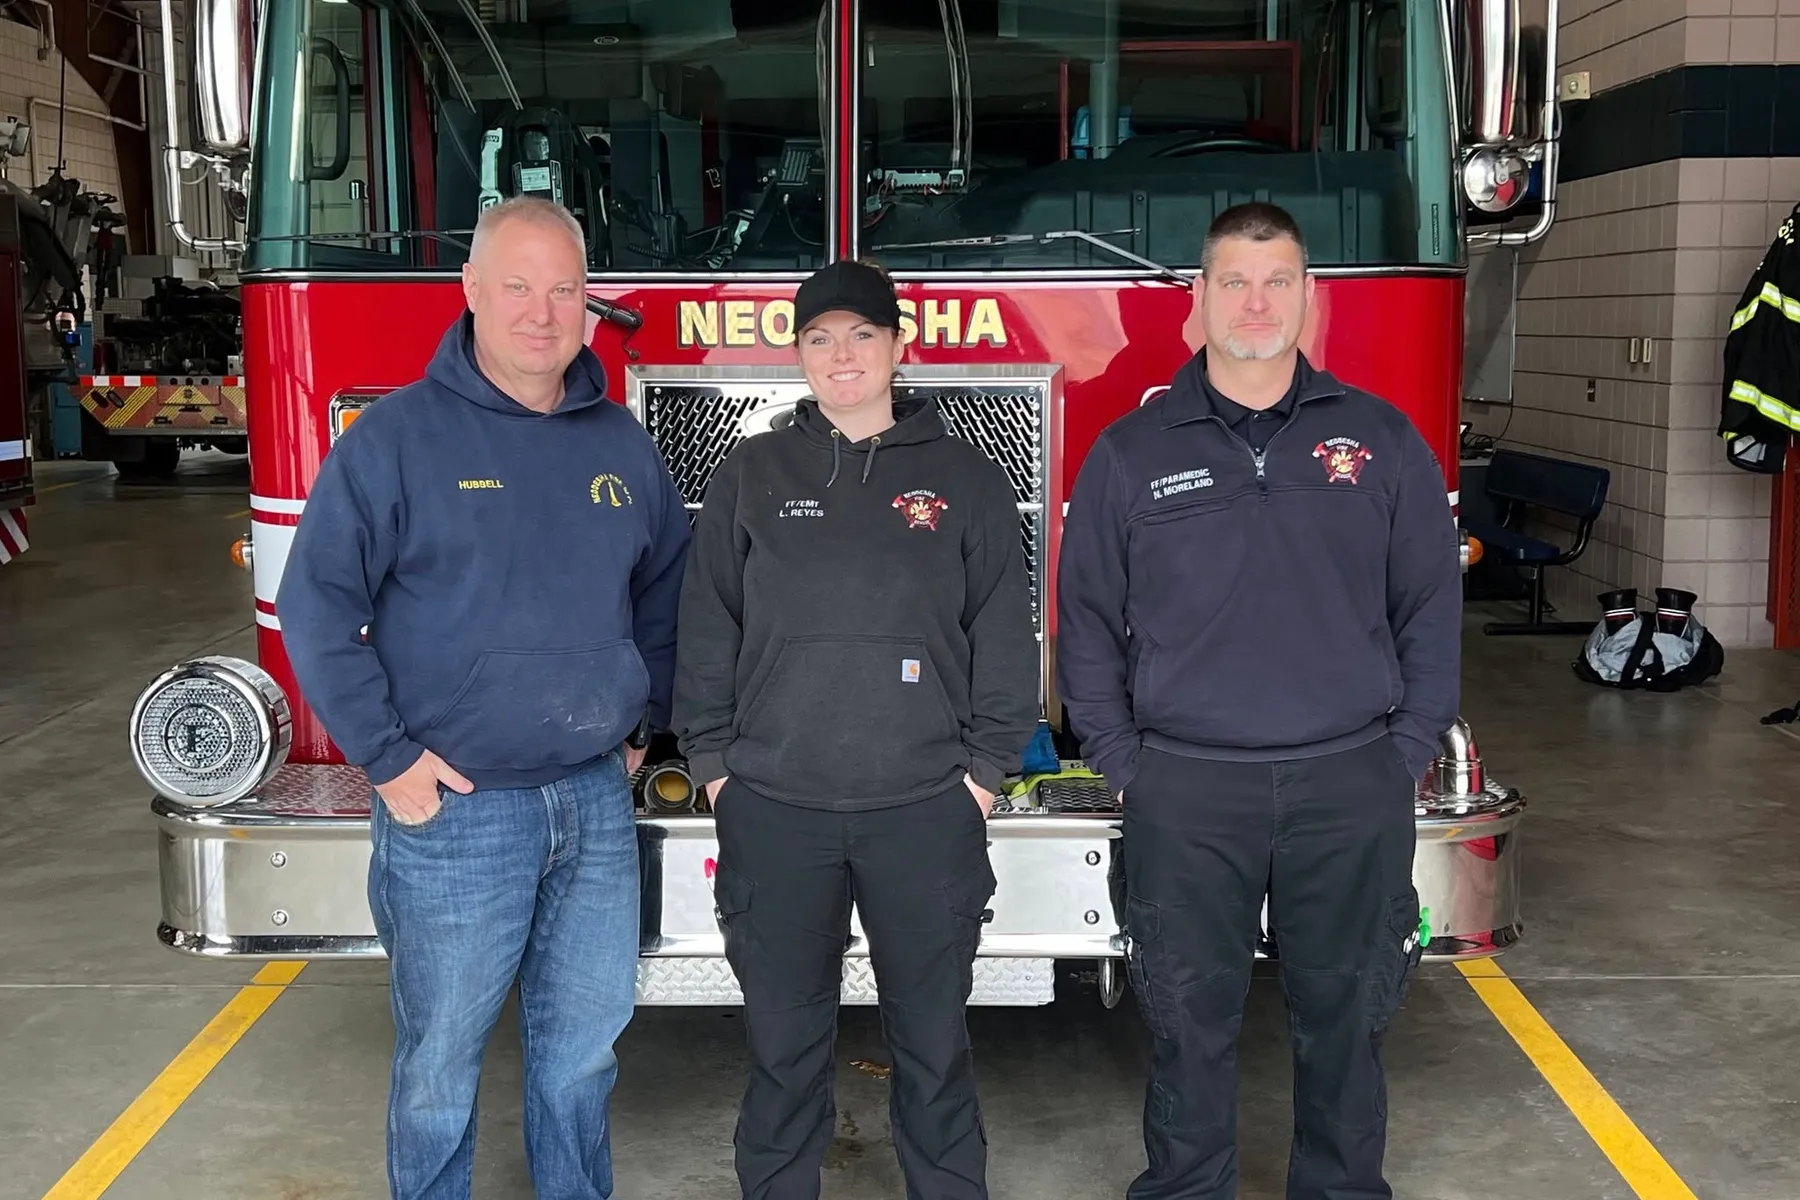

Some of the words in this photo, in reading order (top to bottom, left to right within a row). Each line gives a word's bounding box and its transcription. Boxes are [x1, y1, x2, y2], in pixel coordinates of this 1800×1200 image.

[678, 298, 1007, 347] NEOSHA
[458, 479, 504, 490] HUBBELL
[1150, 468, 1210, 490] FF/PARAMEDIC
[1163, 478, 1214, 497] MORELAND
[785, 499, 820, 508] FF/EMT
[779, 509, 788, 518] L.
[790, 508, 824, 517] REYES
